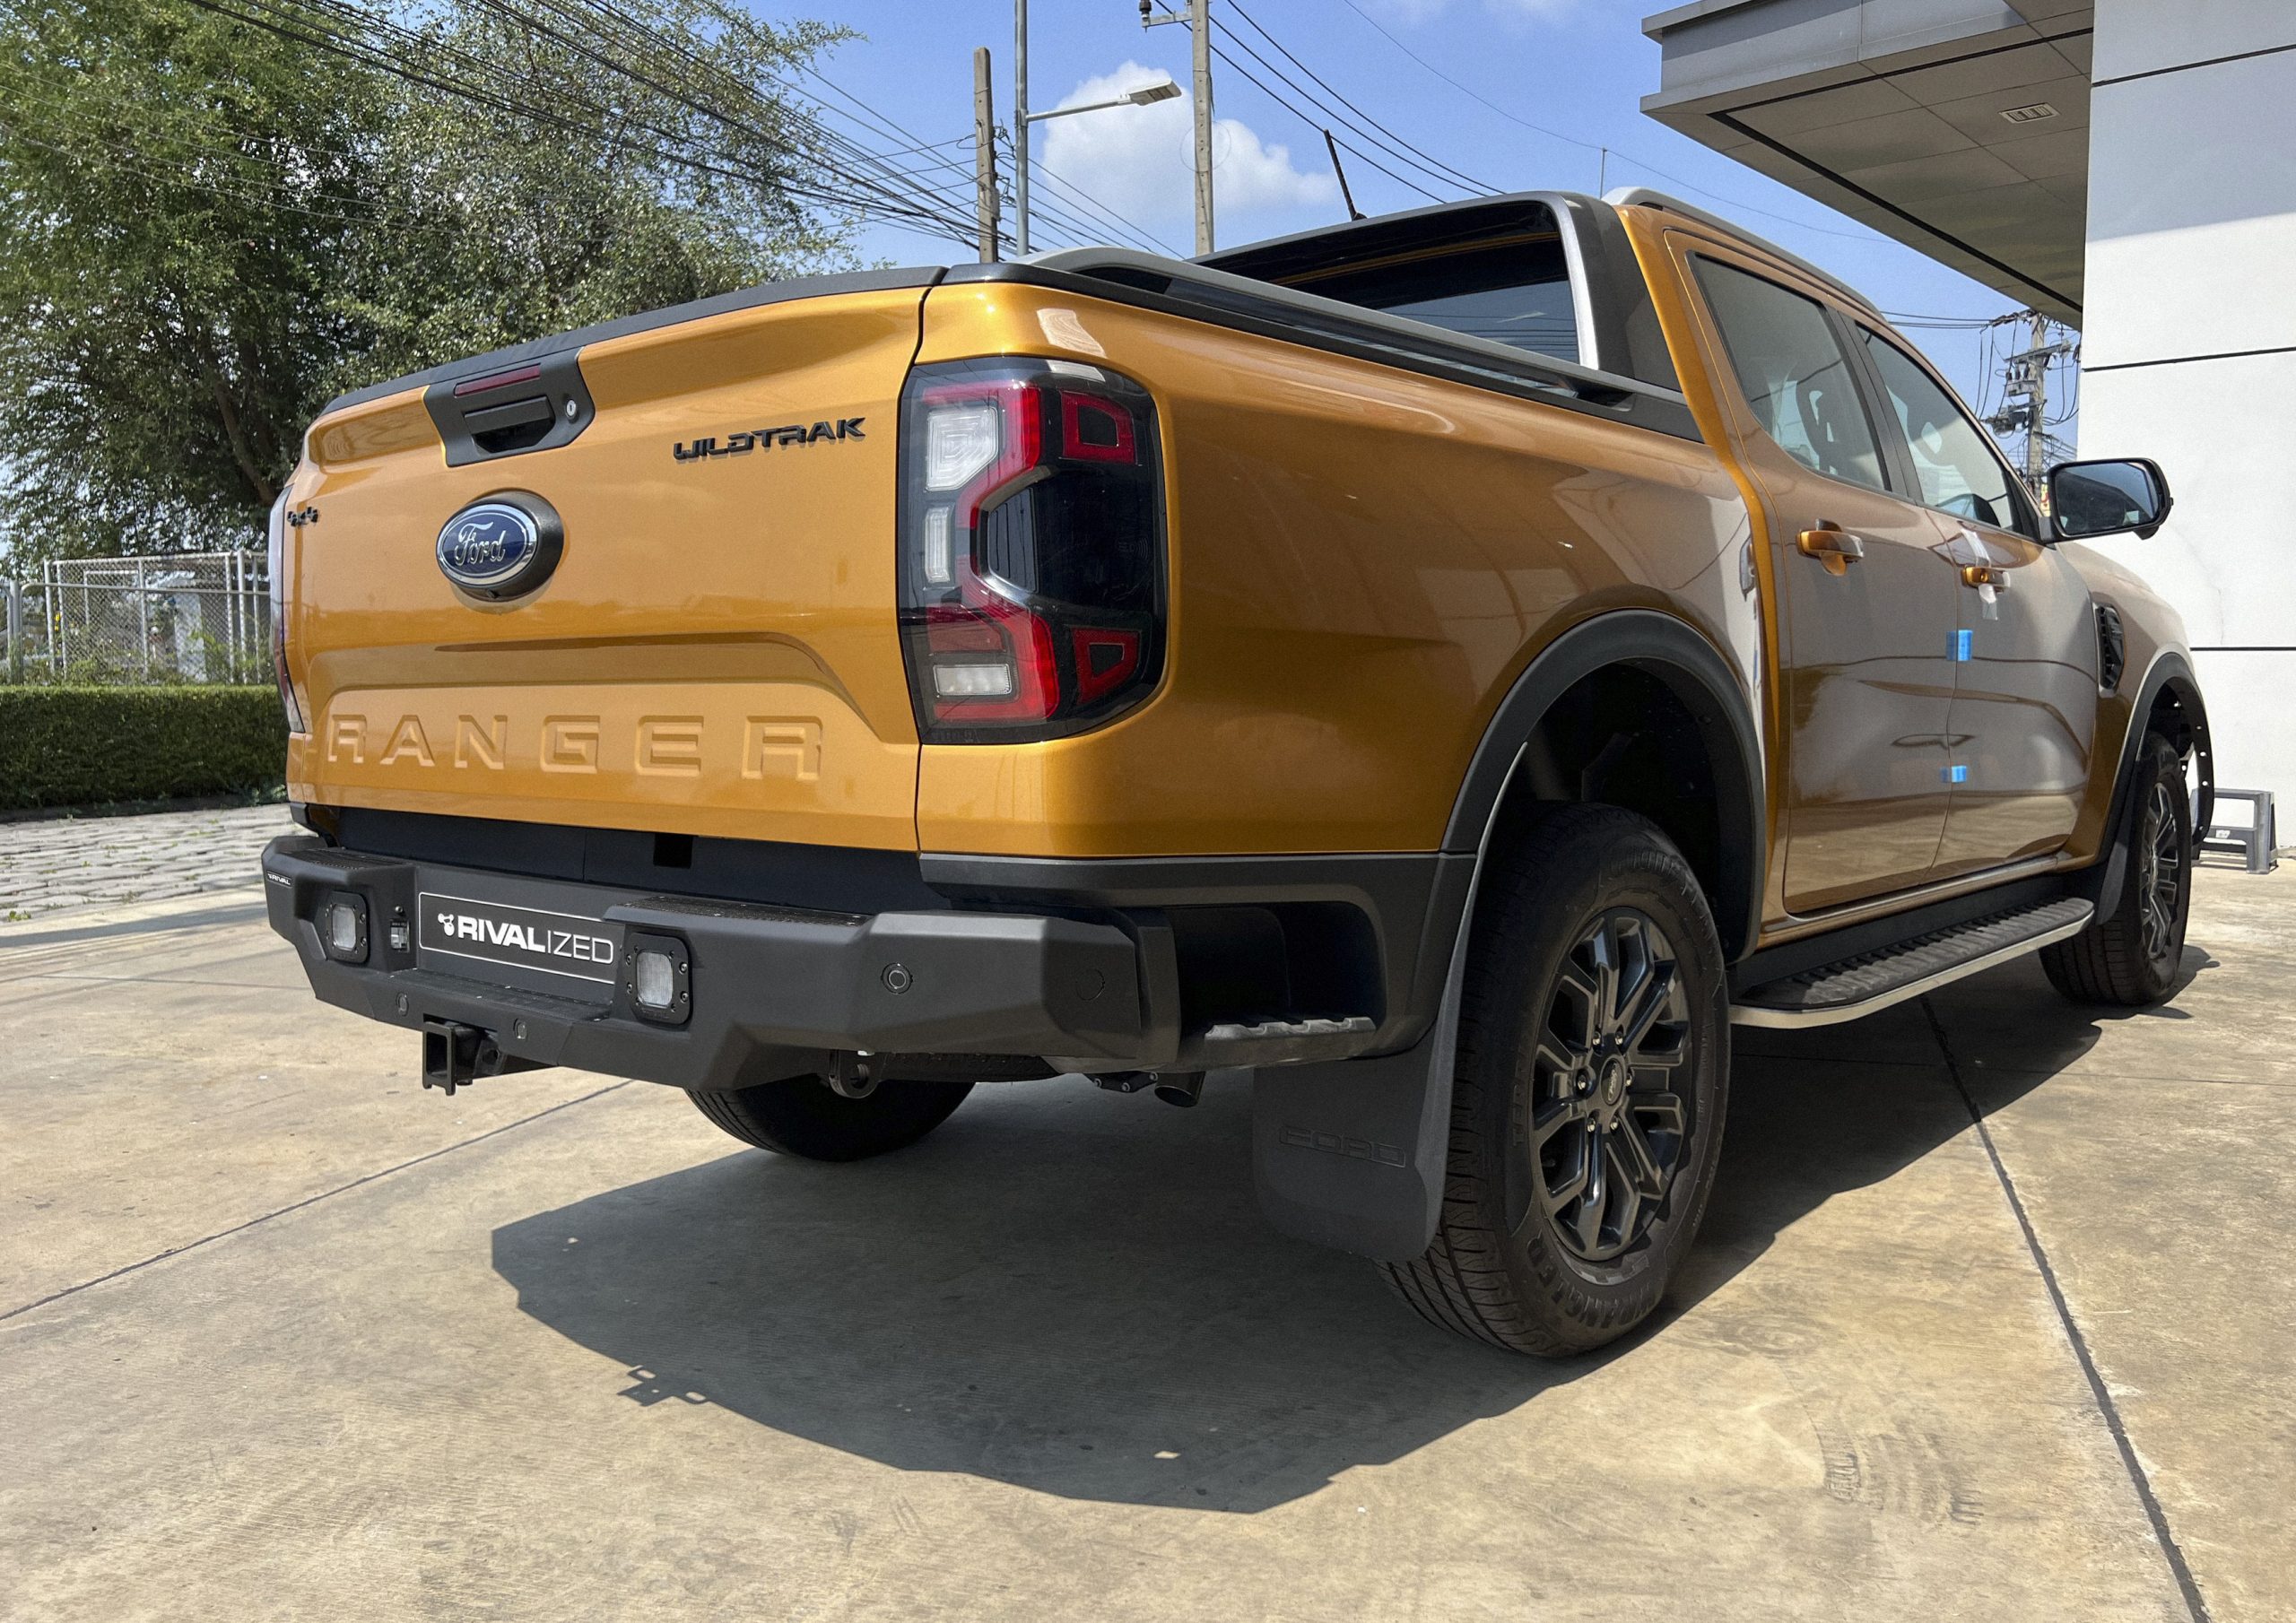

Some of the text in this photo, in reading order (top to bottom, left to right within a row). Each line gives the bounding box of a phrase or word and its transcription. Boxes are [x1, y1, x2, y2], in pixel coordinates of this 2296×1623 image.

[674, 417, 865, 461] WILDTRAK
[455, 521, 506, 566] Ford
[327, 715, 823, 780] RANGER
[272, 874, 291, 885] RIVAL
[457, 915, 613, 965] RIVALIZED
[1278, 1122, 1406, 1168] FORD
